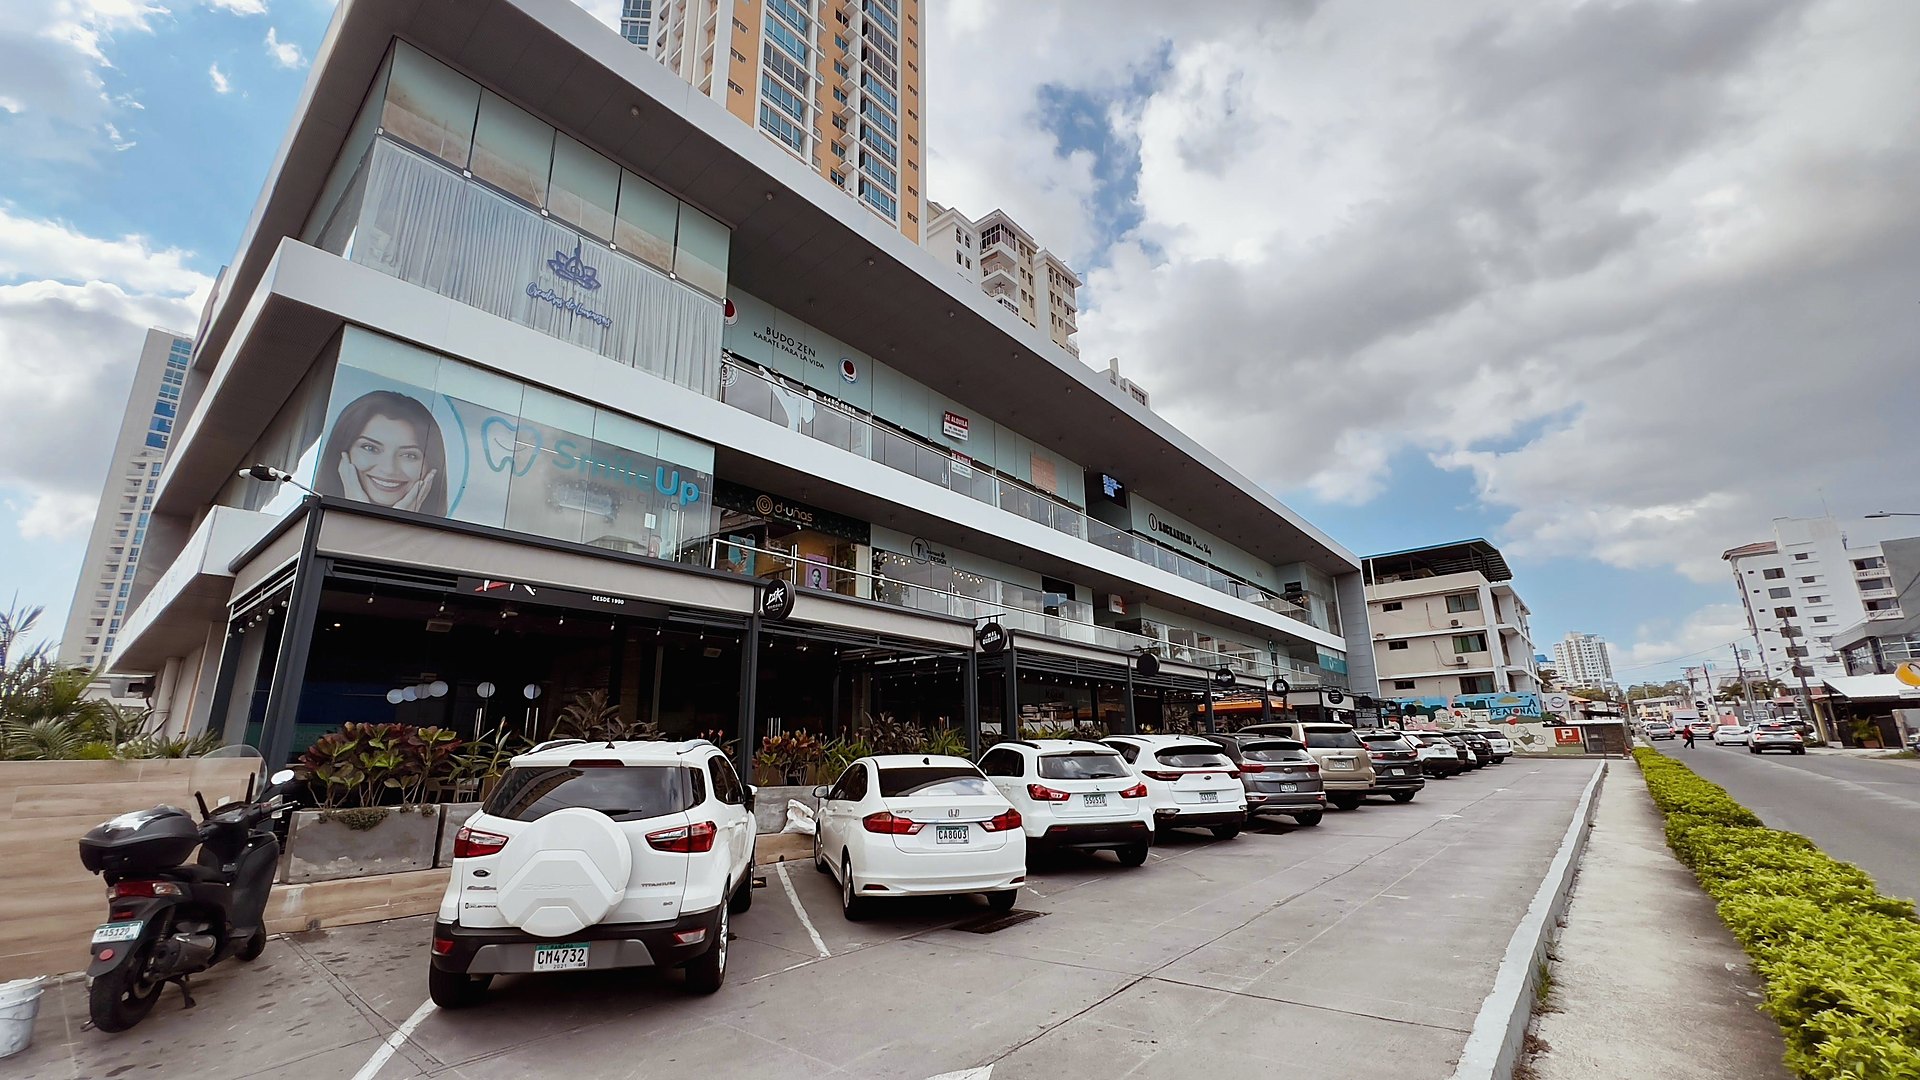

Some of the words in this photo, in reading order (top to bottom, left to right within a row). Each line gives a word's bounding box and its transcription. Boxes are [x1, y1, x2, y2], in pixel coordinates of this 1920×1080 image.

[565, 297, 576, 310] de
[766, 326, 795, 347] BUDO
[797, 342, 816, 357] ZEN
[753, 331, 780, 348] KARATE
[781, 344, 799, 358] PARA
[800, 354, 808, 362] LA
[809, 358, 825, 369] VIDA
[945, 413, 951, 422] SE
[951, 415, 968, 428] ALQUILA
[592, 595, 610, 603] DESDE
[1490, 707, 1540, 716] PEATONAL
[1561, 729, 1573, 740] P
[938, 830, 967, 840] CA8003
[537, 948, 585, 965] CM4732
